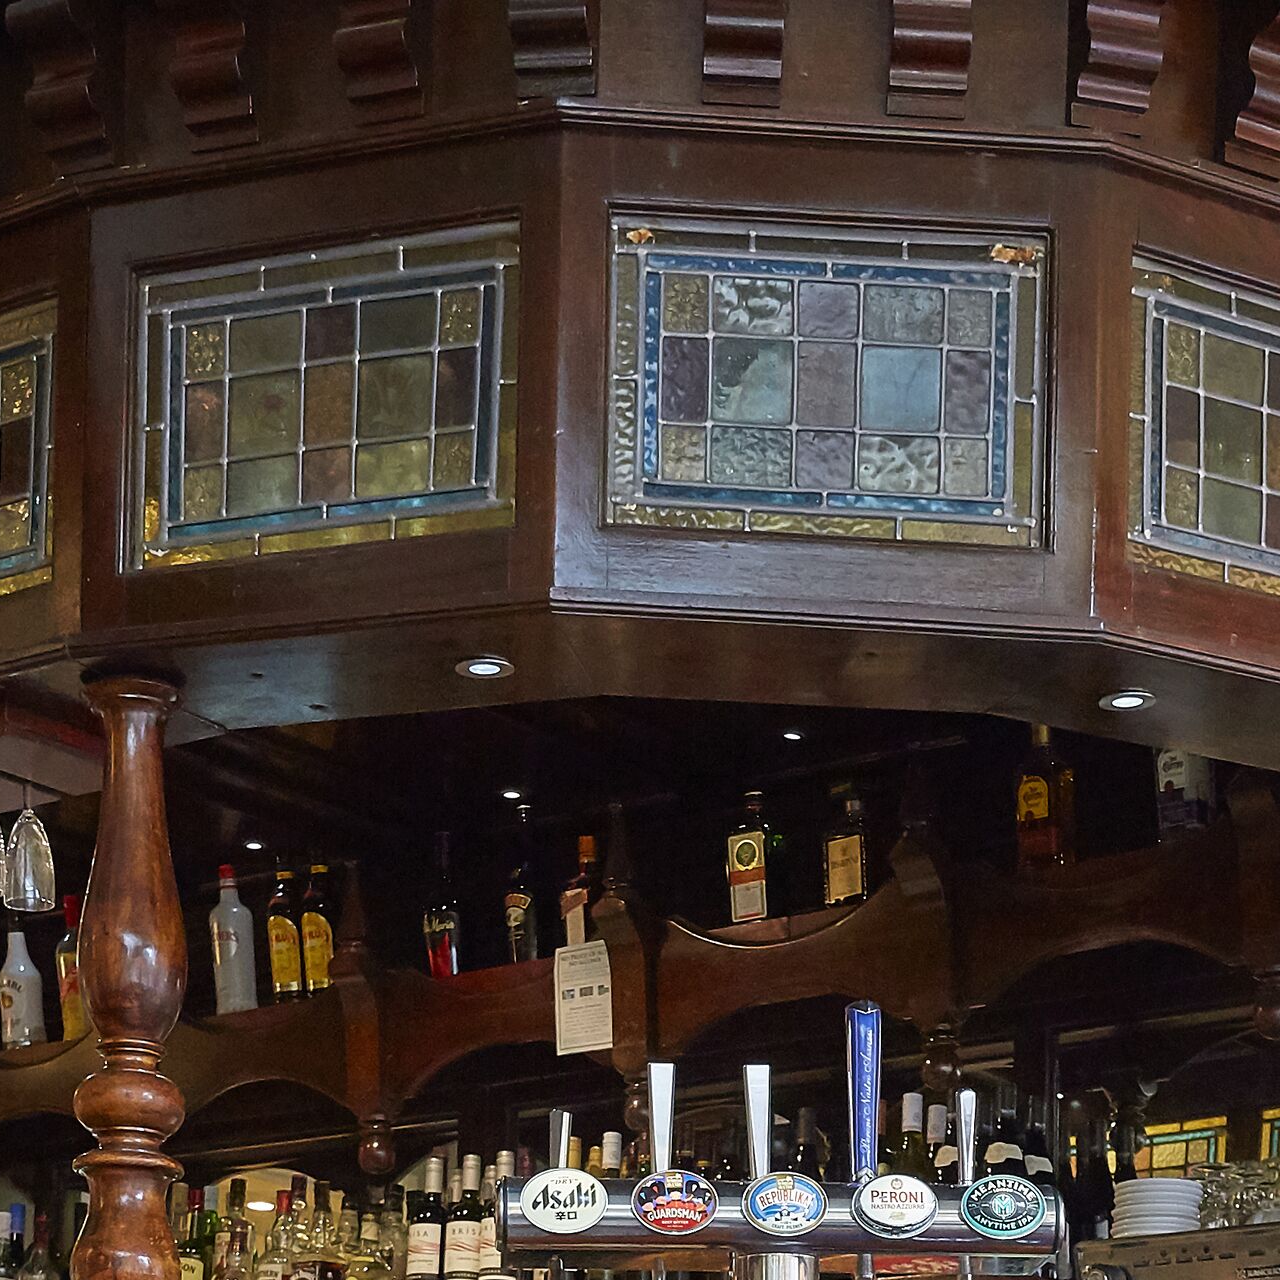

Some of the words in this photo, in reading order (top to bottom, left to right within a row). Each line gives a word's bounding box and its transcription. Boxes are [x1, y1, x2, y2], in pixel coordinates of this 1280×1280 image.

[860, 1076, 872, 1115] Nastro
[860, 1117, 871, 1155] Peroni
[531, 1182, 597, 1211] Asahi
[758, 1189, 811, 1207] REPUBLIKA
[871, 1190, 924, 1203] PERONI
[970, 1178, 1037, 1202] MEANTIME
[647, 1207, 703, 1222] GUARDSMAN
[973, 1214, 1017, 1230] ANYTIME
[1018, 1214, 1035, 1227] IPA
